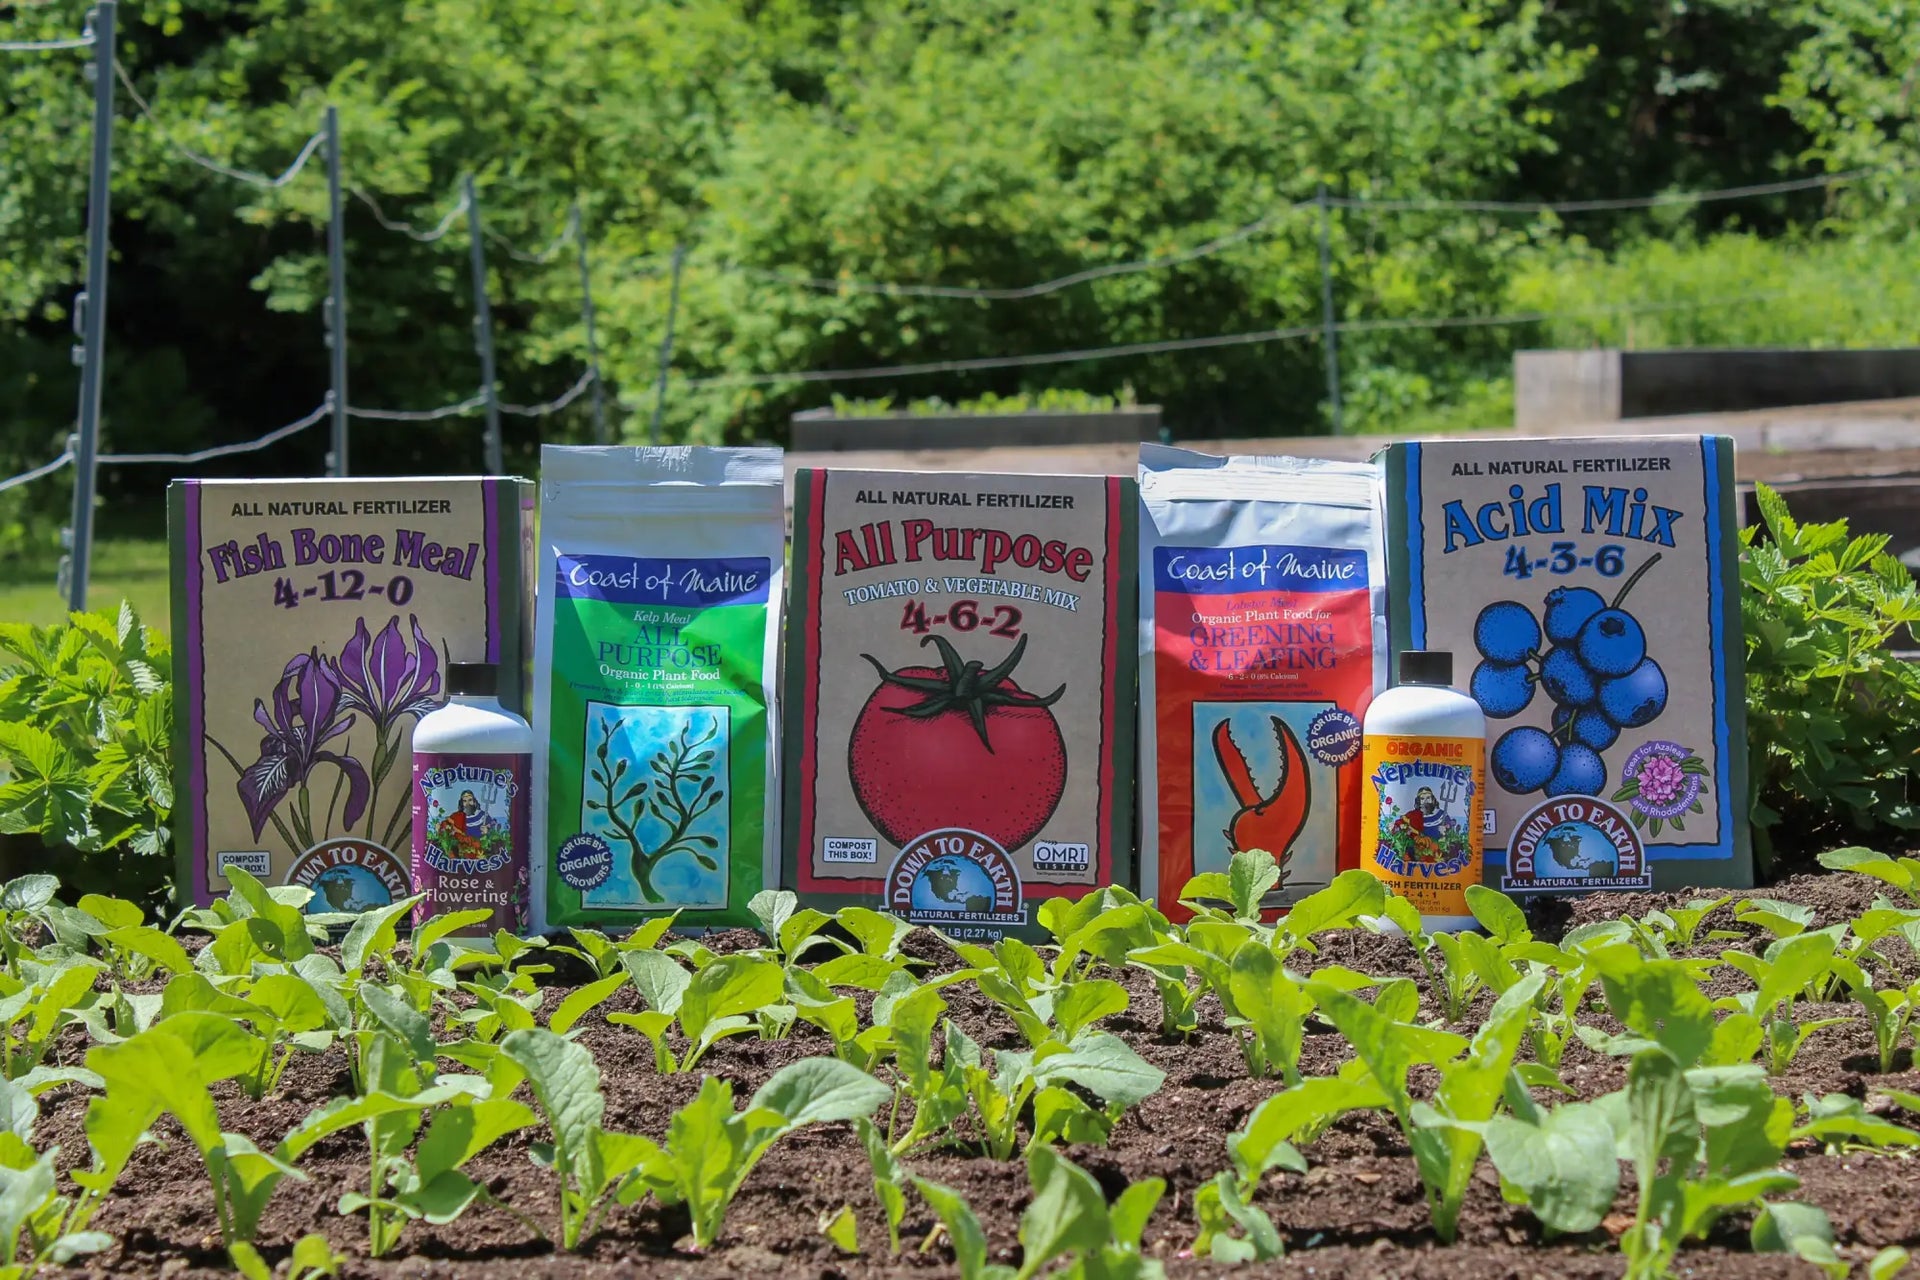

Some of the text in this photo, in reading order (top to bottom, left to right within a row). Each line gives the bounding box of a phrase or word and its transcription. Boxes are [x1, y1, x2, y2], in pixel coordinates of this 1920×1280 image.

[1451, 457, 1671, 477] ALL NATURAL FERTILIZER
[231, 500, 451, 517] ALL NATURAL FERTILIZER
[855, 490, 1074, 509] ALL NATURAL FERTILIZER
[1442, 482, 1684, 554] Acid Mix
[207, 528, 480, 584] Fish Bone Meal
[834, 519, 1093, 582] All Purpose
[1503, 541, 1626, 580] 4-3-6
[1167, 549, 1355, 585] Coast of Maine
[273, 570, 415, 609] 4-12-0
[569, 562, 757, 600] Coast of Maine
[843, 576, 1081, 613] TOMATO & VEGETABLE MIX
[634, 610, 691, 624] Kelp Meal
[900, 599, 1022, 639] 4-6-2
[1192, 608, 1332, 625] Organic Plant Food for
[634, 624, 688, 646] ALL
[1190, 624, 1336, 647] GREENING
[597, 640, 722, 668] PURPOSE
[1189, 647, 1338, 671] & LEAFING
[600, 664, 720, 681] Organic Plant Food
[1311, 712, 1356, 736] FOR USE BY
[1310, 726, 1361, 749] ORGANIC
[1386, 741, 1463, 757] ORGANIC
[1317, 740, 1360, 763] GROWERS
[1624, 742, 1686, 777] Great for Azaleas
[419, 763, 519, 798] Neptune's
[1633, 775, 1698, 816] and Rhododendrons
[560, 837, 605, 860] FOR USE BY
[828, 841, 872, 850] COMPOST
[1516, 812, 1554, 873] DOWN
[1553, 803, 1584, 821] TO
[1588, 806, 1636, 871] EARTH
[222, 855, 266, 864] COMPOST
[424, 843, 511, 875] Harvest
[559, 852, 610, 872] ORGANIC
[828, 851, 872, 860] THIS BOX!
[1037, 846, 1086, 862] OMRI
[1376, 843, 1470, 878] Harvest
[296, 854, 328, 886] WN
[328, 847, 358, 863] TO
[361, 850, 407, 904] EART
[439, 875, 494, 889] Rose &
[566, 864, 609, 887] GROWERS
[894, 837, 1013, 908] DOWN TO EARTH
[1510, 877, 1644, 887] ALL NATURAL FERTILIZERS
[426, 888, 508, 906] Flowering
[1404, 881, 1462, 890] FERTILIZER
[910, 910, 955, 919] NATURAL
[958, 912, 1019, 921] FERTILIZERS
[948, 928, 961, 937] LB
[963, 929, 986, 939] (2.27
[987, 930, 1002, 940] kg)
